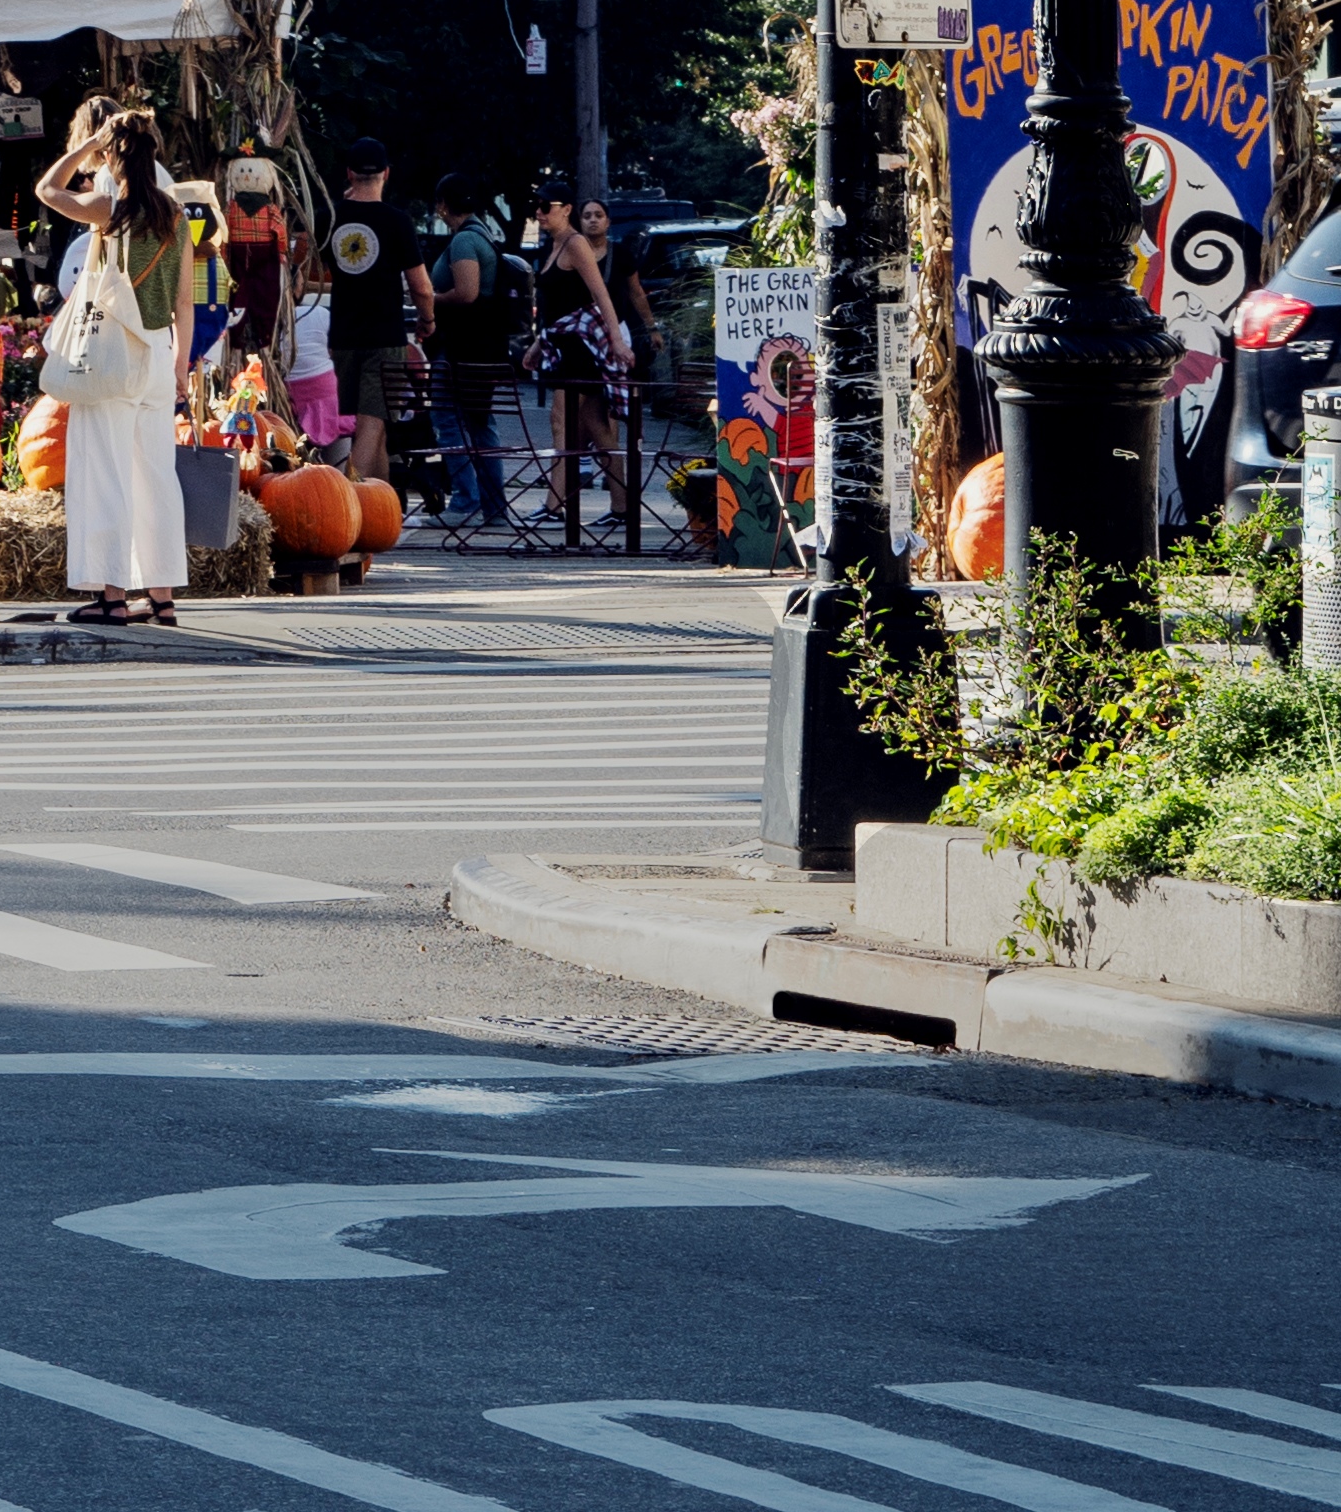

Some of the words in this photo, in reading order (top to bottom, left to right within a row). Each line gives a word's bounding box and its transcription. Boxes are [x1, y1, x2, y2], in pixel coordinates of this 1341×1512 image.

[1163, 52, 1270, 170] PATCH
[726, 273, 760, 294] THE
[725, 293, 809, 317] PUMPKIN
[727, 317, 783, 340] HERE!
